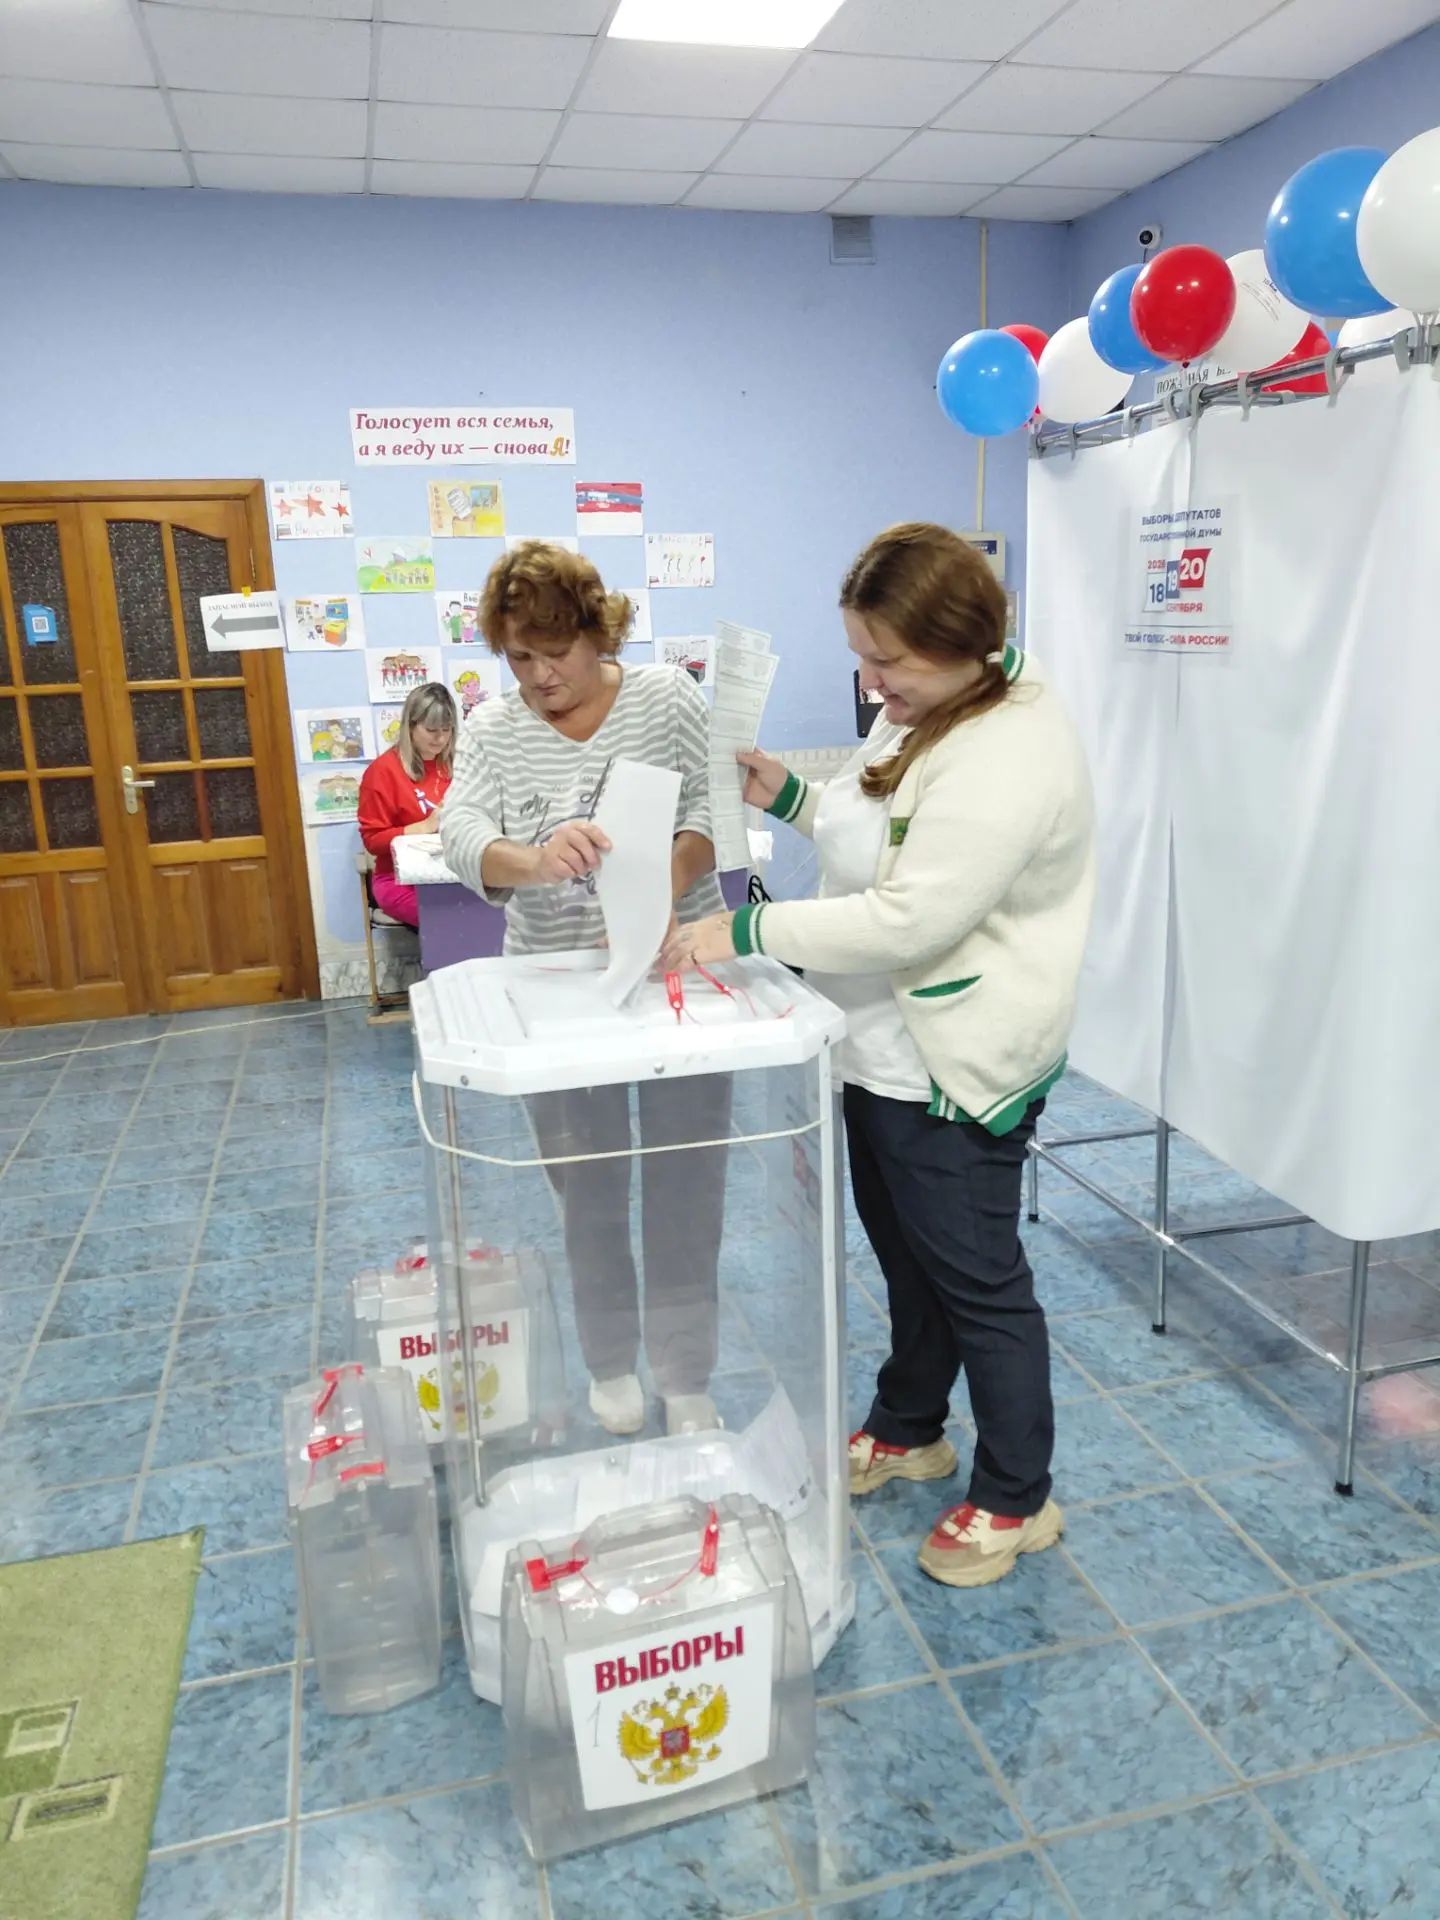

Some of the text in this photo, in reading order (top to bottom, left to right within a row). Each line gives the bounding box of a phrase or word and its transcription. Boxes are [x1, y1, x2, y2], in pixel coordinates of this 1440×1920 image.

[1156, 367, 1209, 394] ПОЖНАЯ
[355, 413, 554, 433] Голосует вся семья,
[358, 444, 370, 456] а
[374, 444, 387, 456] я
[392, 439, 436, 460] веду
[441, 443, 465, 455] их
[494, 442, 548, 455] снова
[1142, 513, 1175, 525] ВЫБОРЫ
[1197, 528, 1222, 539] ДУМЫ
[1149, 557, 1204, 604] 18 19 20
[595, 1625, 745, 1694] ВЫБОРЫ
